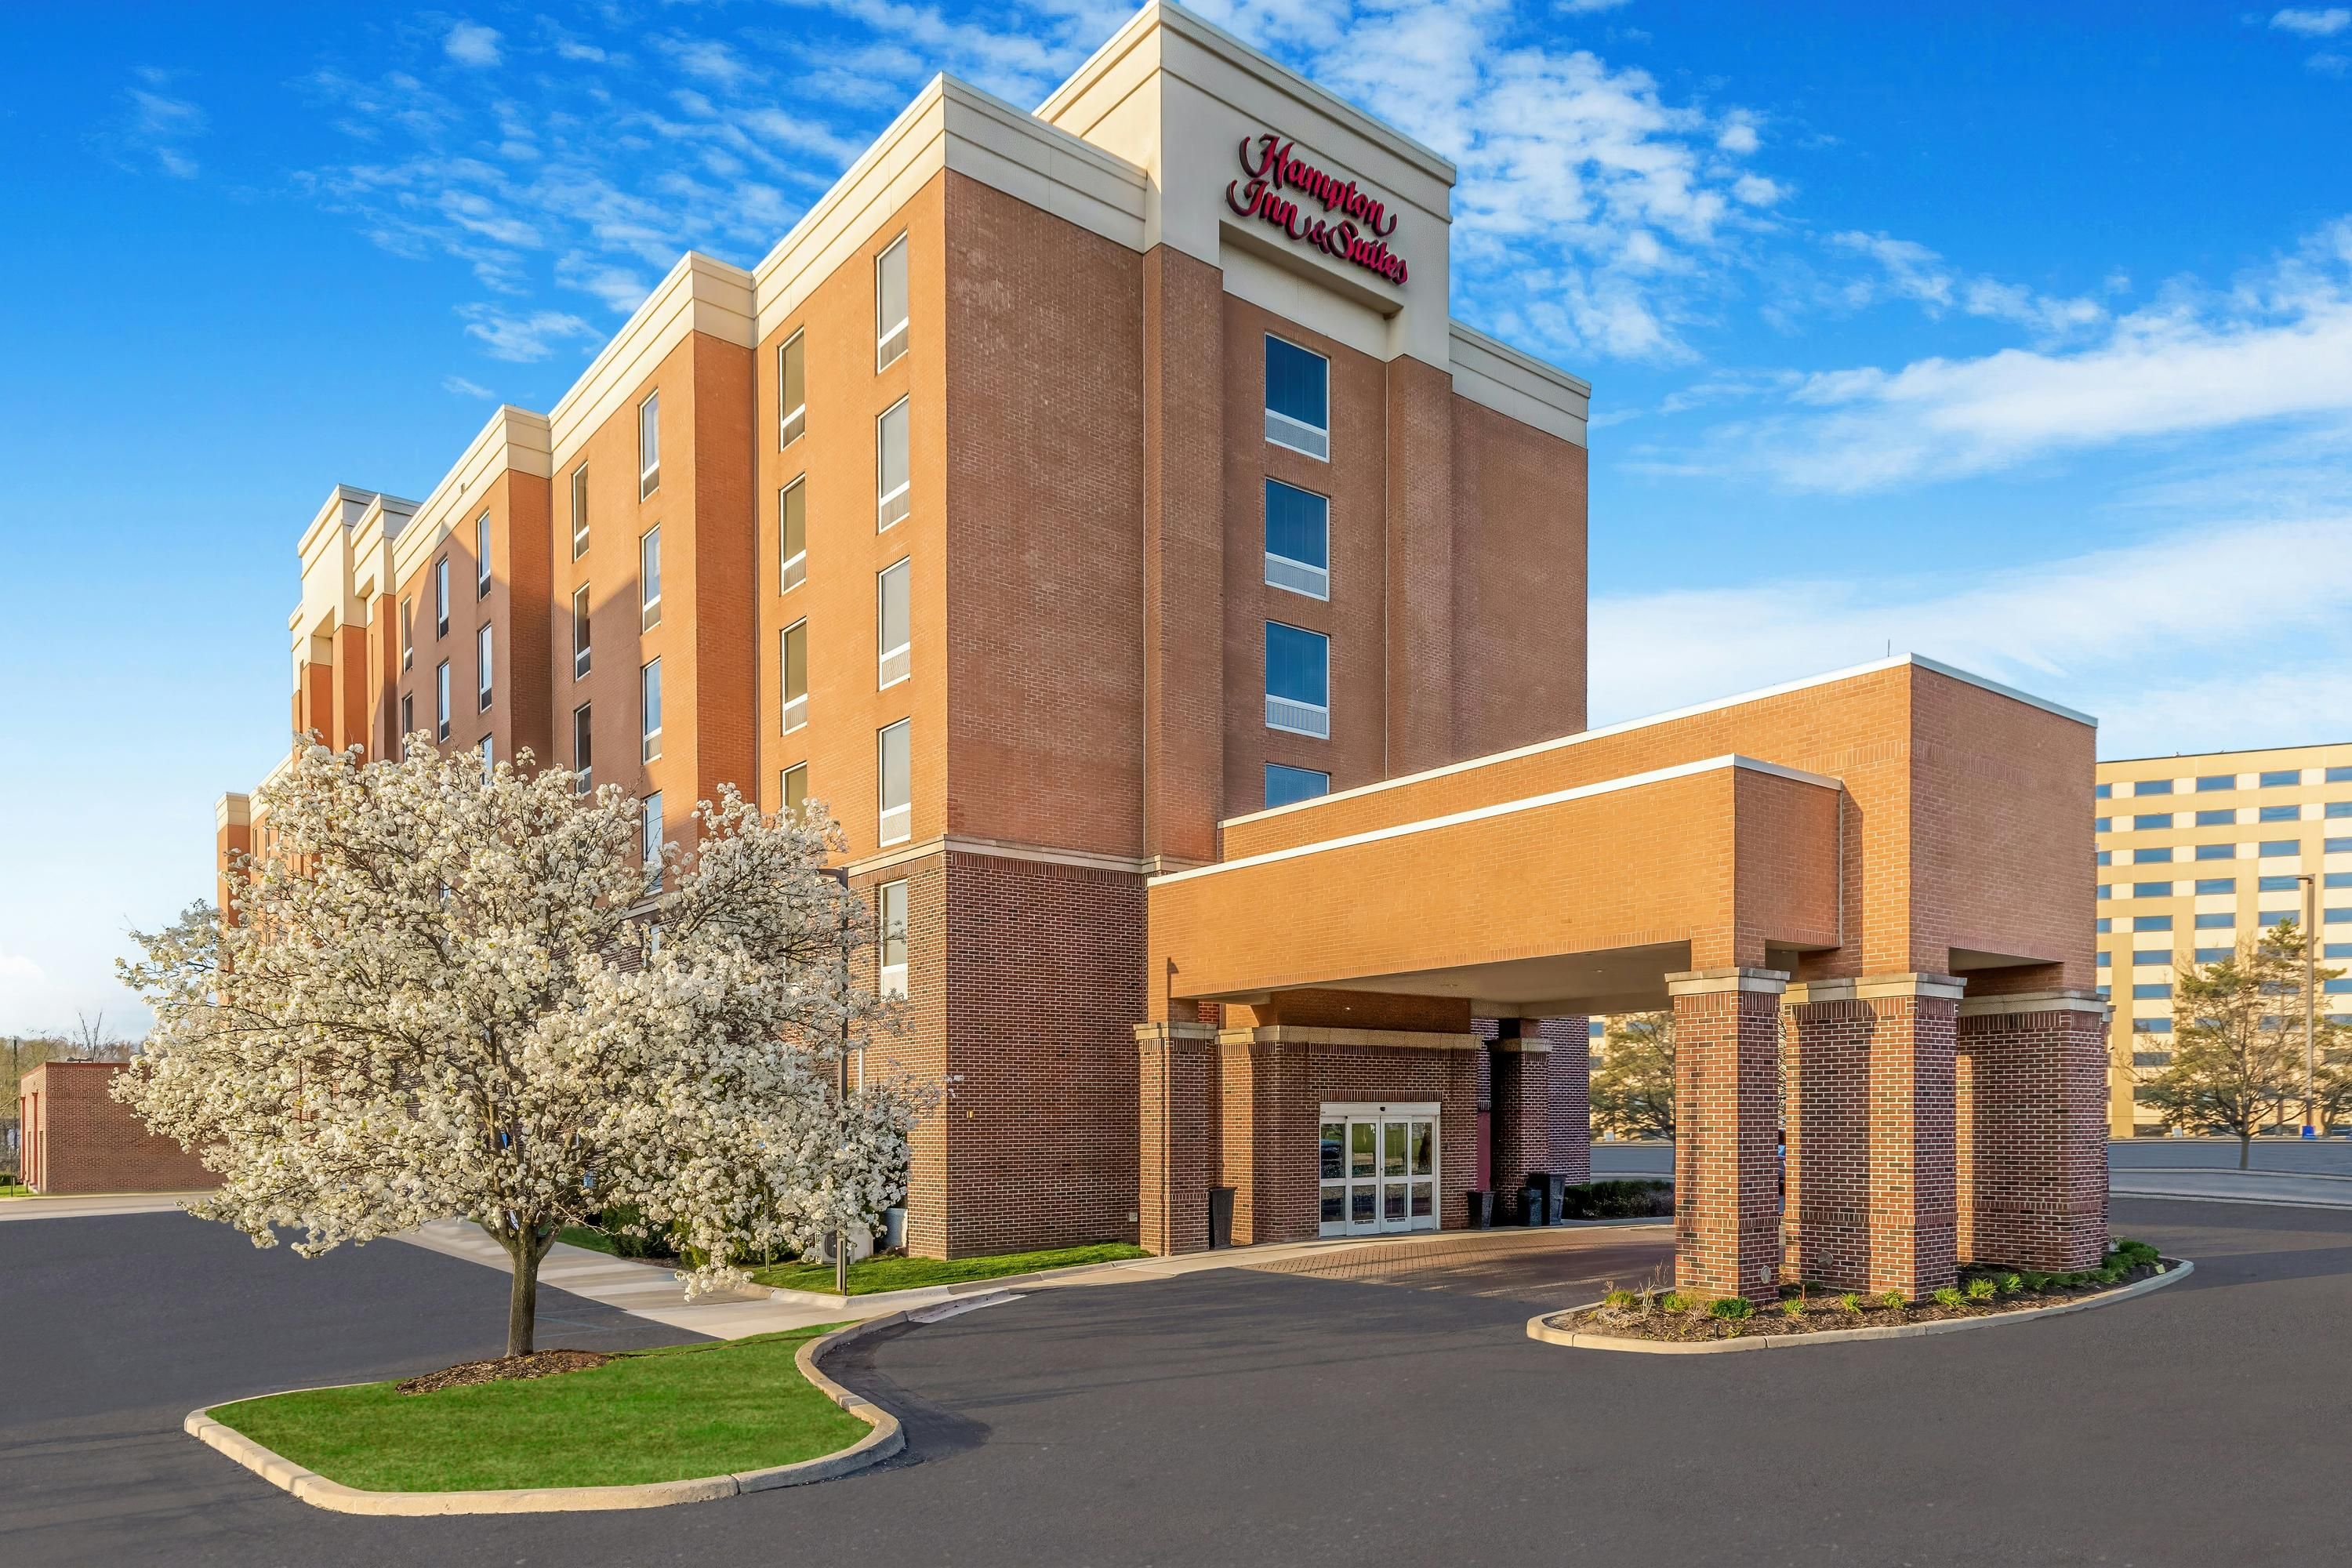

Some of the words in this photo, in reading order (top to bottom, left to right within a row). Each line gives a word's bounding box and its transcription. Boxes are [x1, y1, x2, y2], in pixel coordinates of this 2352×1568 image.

[1226, 179, 1312, 240] Inn
[1307, 220, 1330, 254] &
[1326, 220, 1408, 285] Suites
[1239, 133, 1397, 236] Hampton
